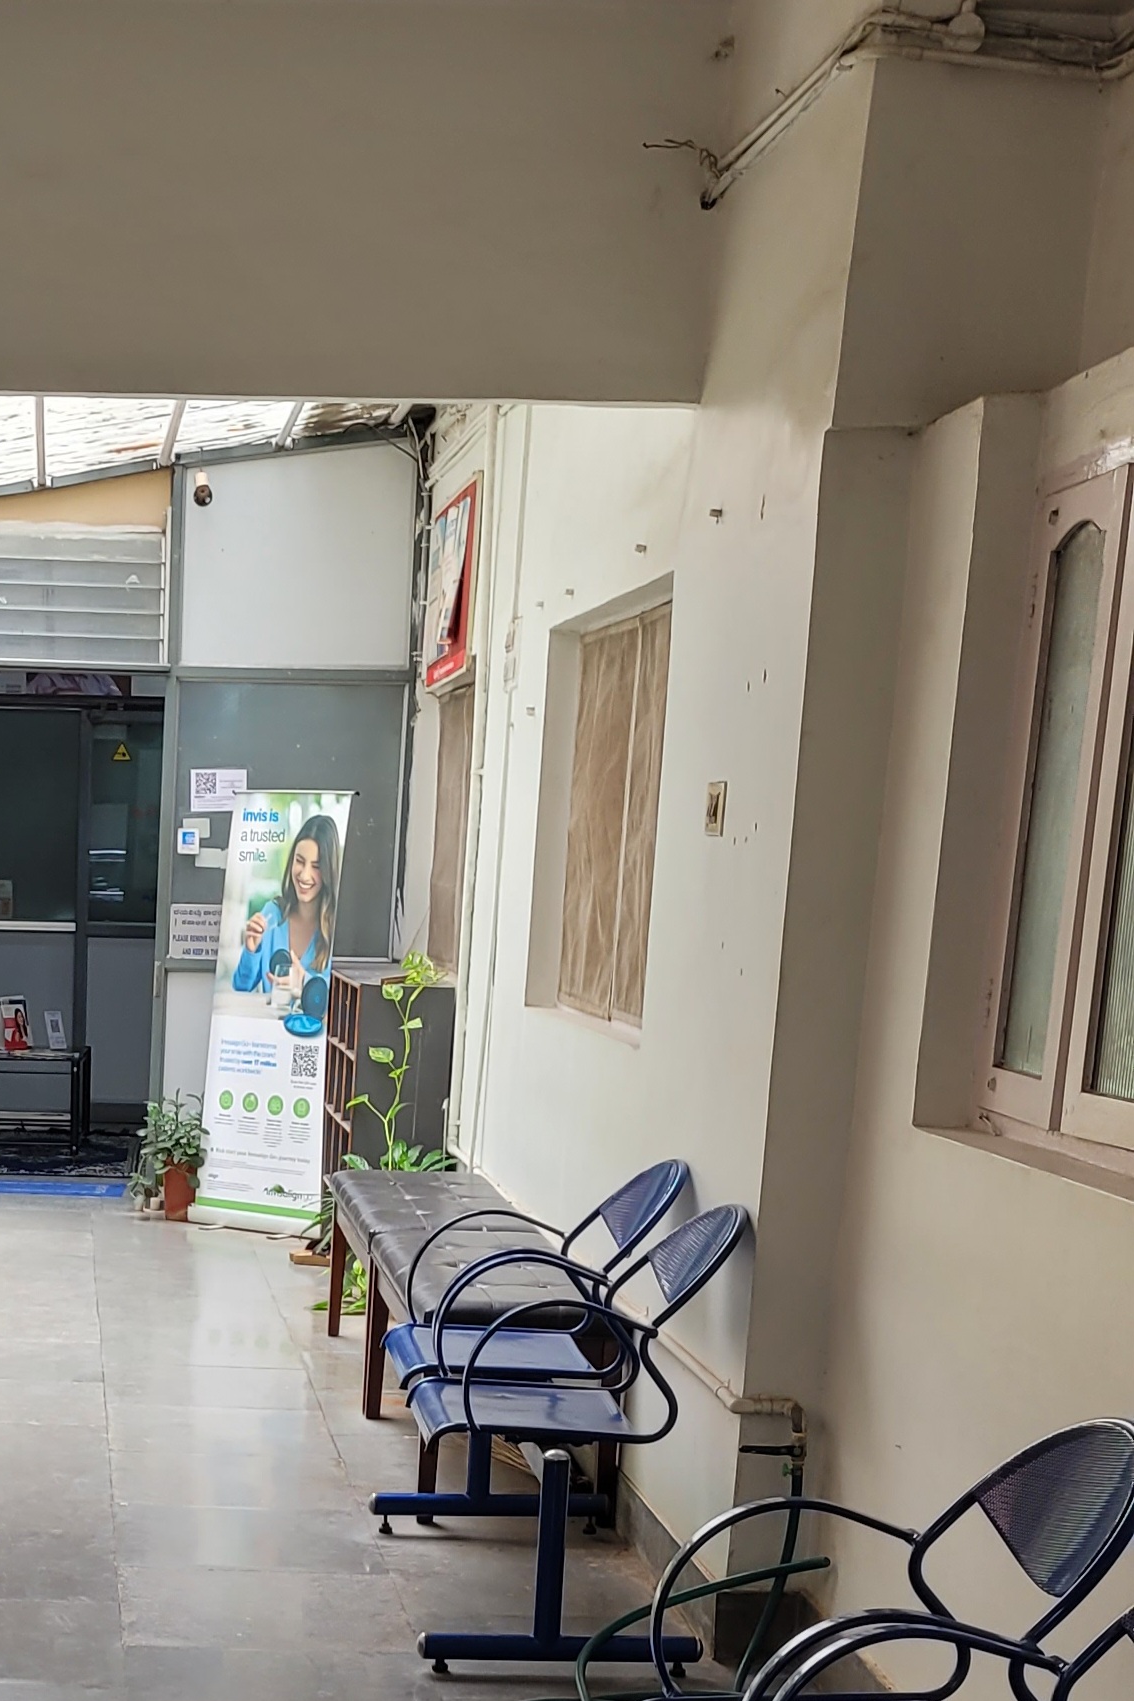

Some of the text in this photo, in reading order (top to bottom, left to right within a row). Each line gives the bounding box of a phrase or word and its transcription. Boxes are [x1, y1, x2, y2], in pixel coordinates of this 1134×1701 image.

[243, 808, 279, 822] invis is
[240, 829, 285, 843] a trusted
[238, 848, 267, 862] smile.
[172, 934, 188, 942] PLEASE
